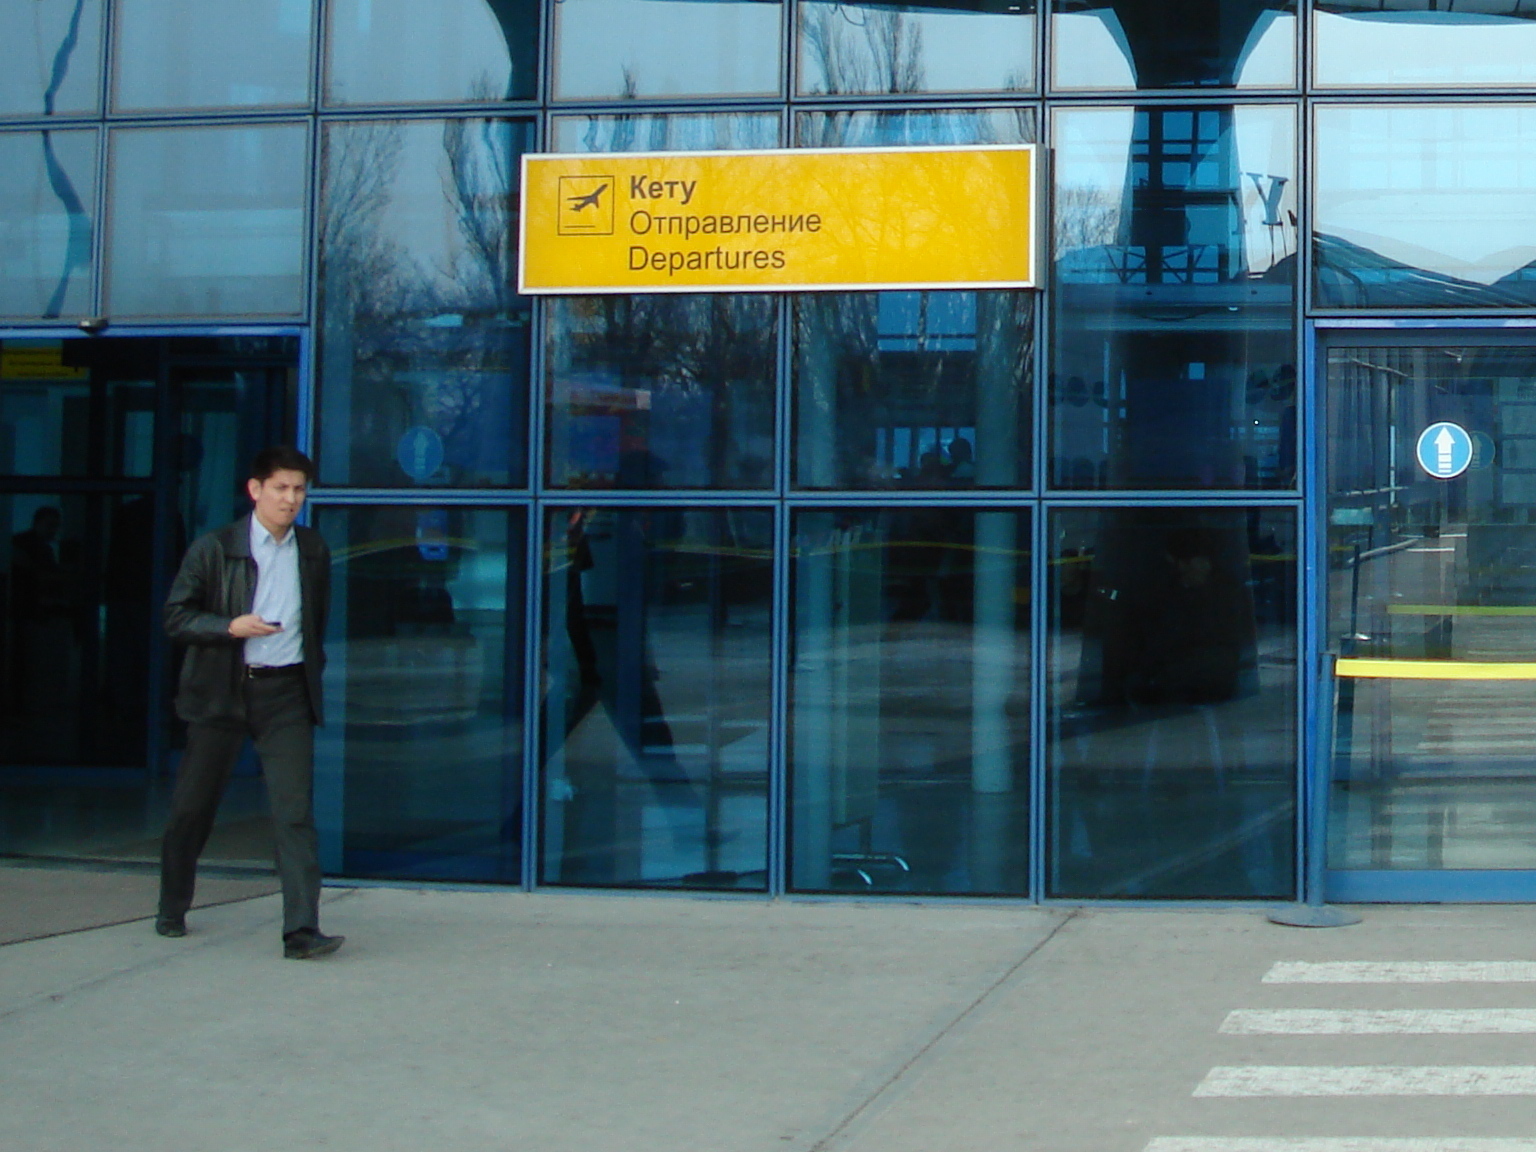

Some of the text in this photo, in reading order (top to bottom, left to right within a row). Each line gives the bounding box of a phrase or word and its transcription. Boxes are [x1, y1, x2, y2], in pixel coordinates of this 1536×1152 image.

[630, 174, 697, 206] Кету
[629, 210, 822, 241] Отправление
[628, 245, 786, 277] Departures
